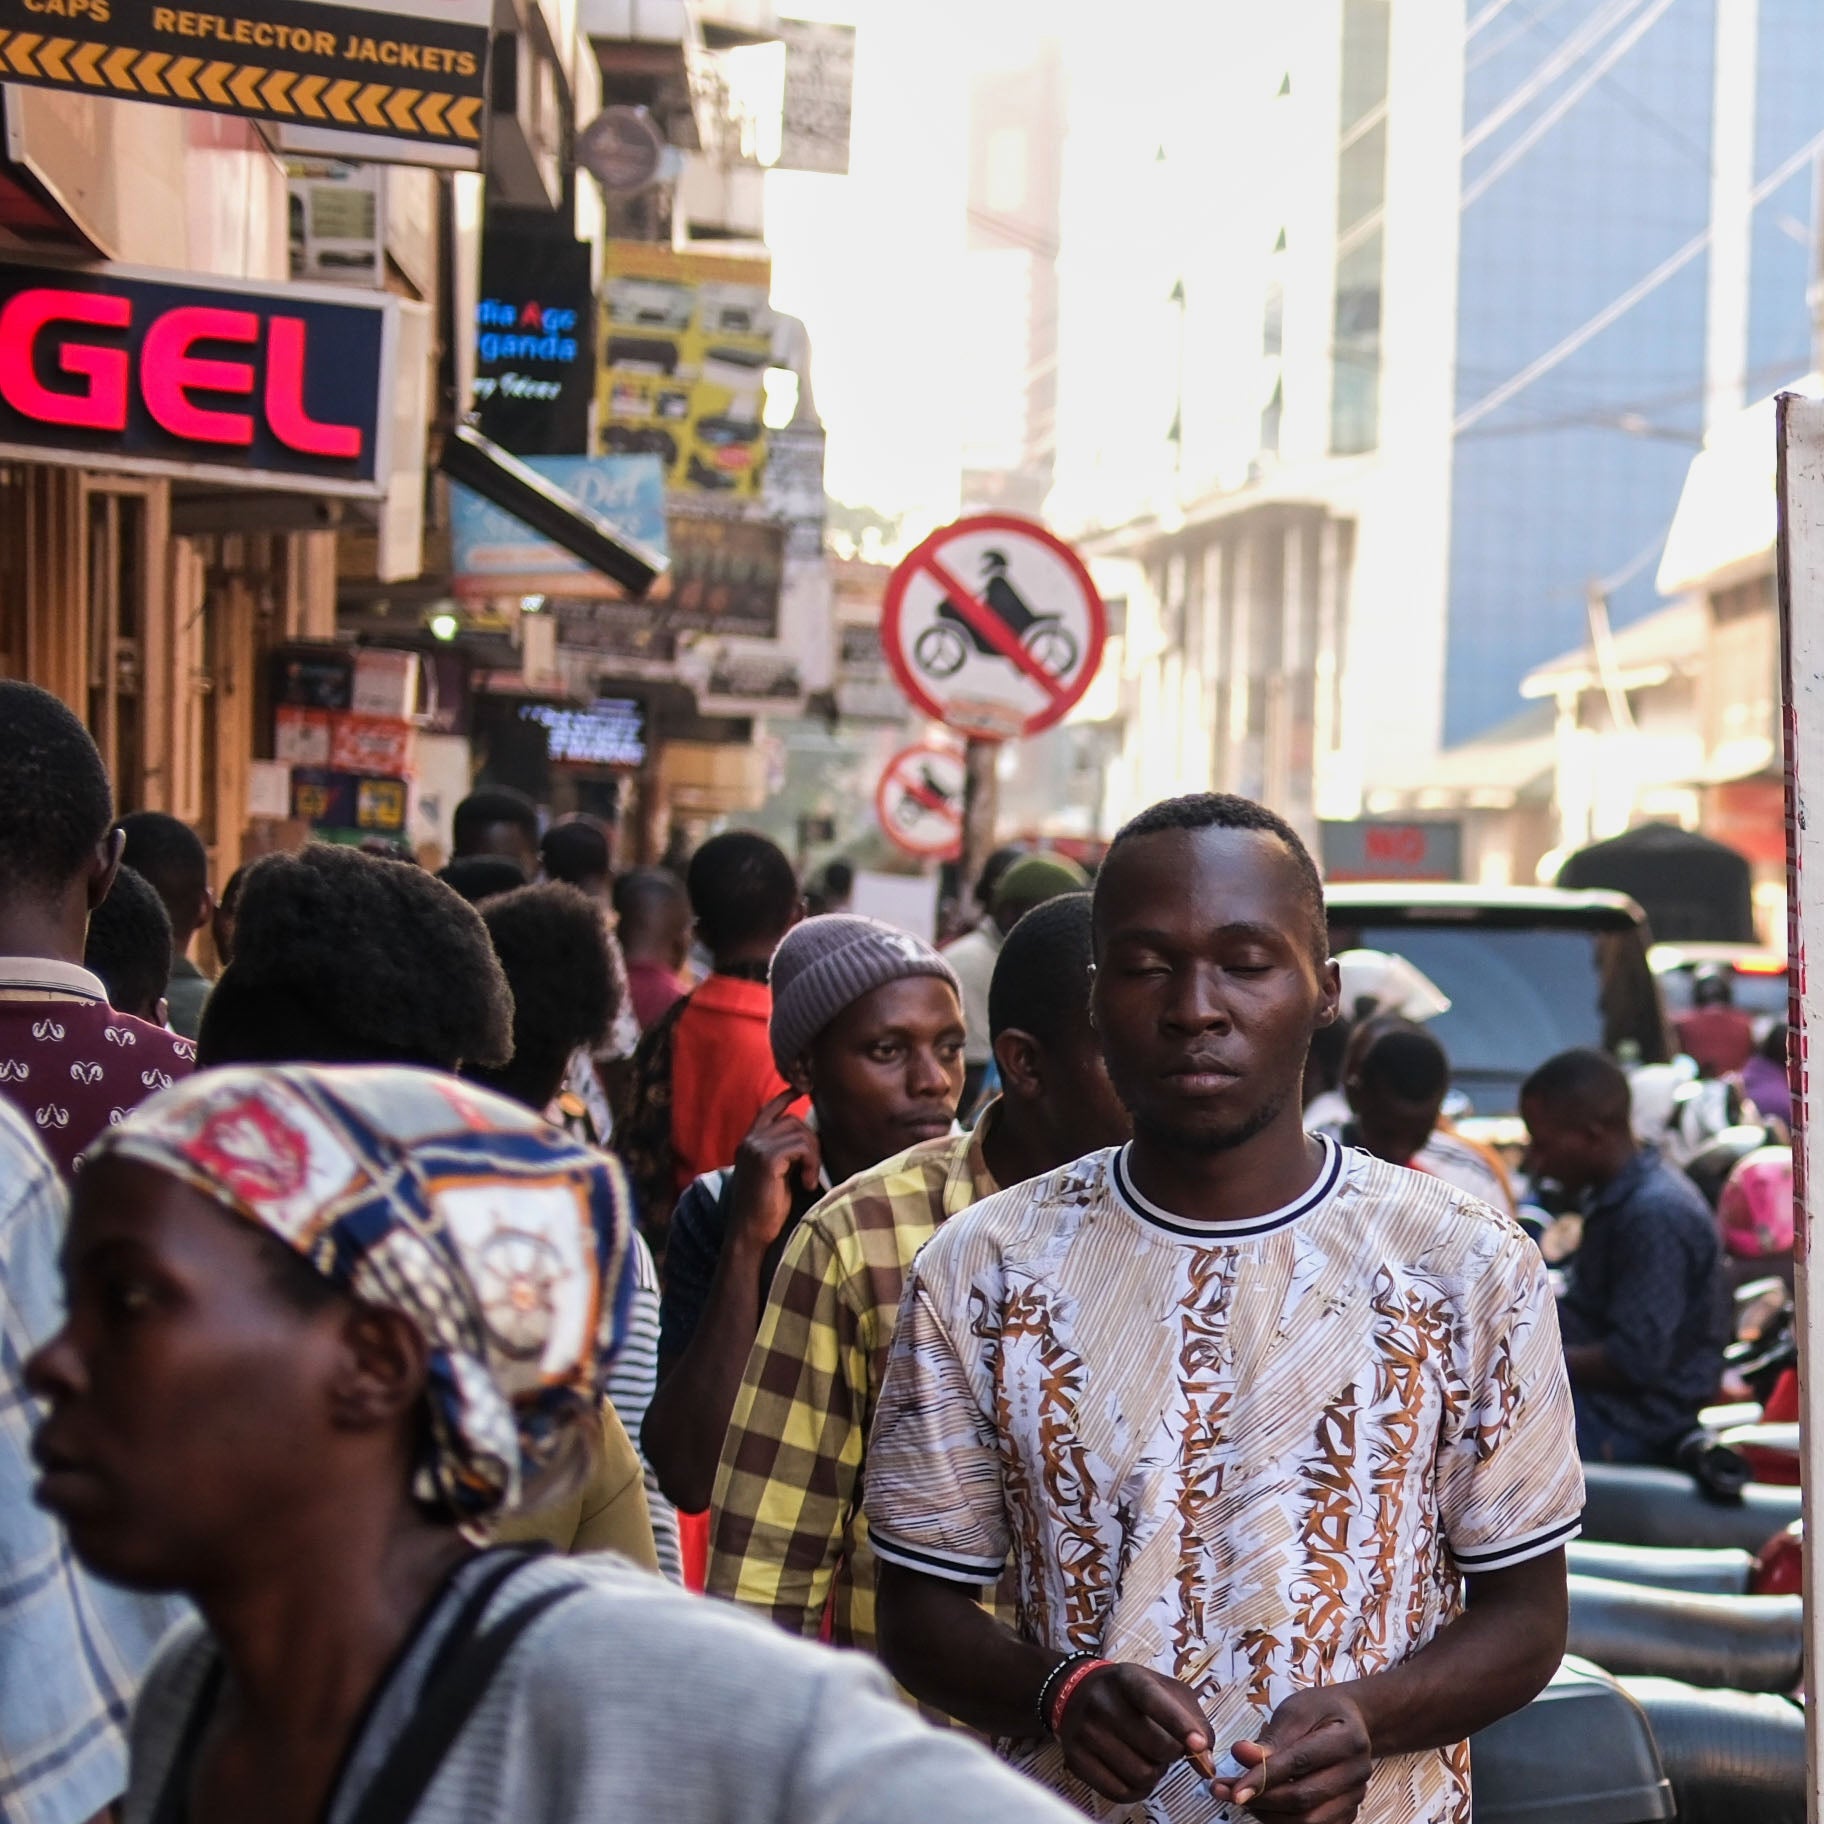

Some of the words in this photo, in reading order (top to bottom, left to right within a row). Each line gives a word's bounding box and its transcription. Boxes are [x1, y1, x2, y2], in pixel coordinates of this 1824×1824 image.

[151, 6, 337, 56] REFLECTOR
[342, 34, 478, 77] JACKETS
[0, 287, 362, 459] GEL
[477, 332, 578, 363] ganda
